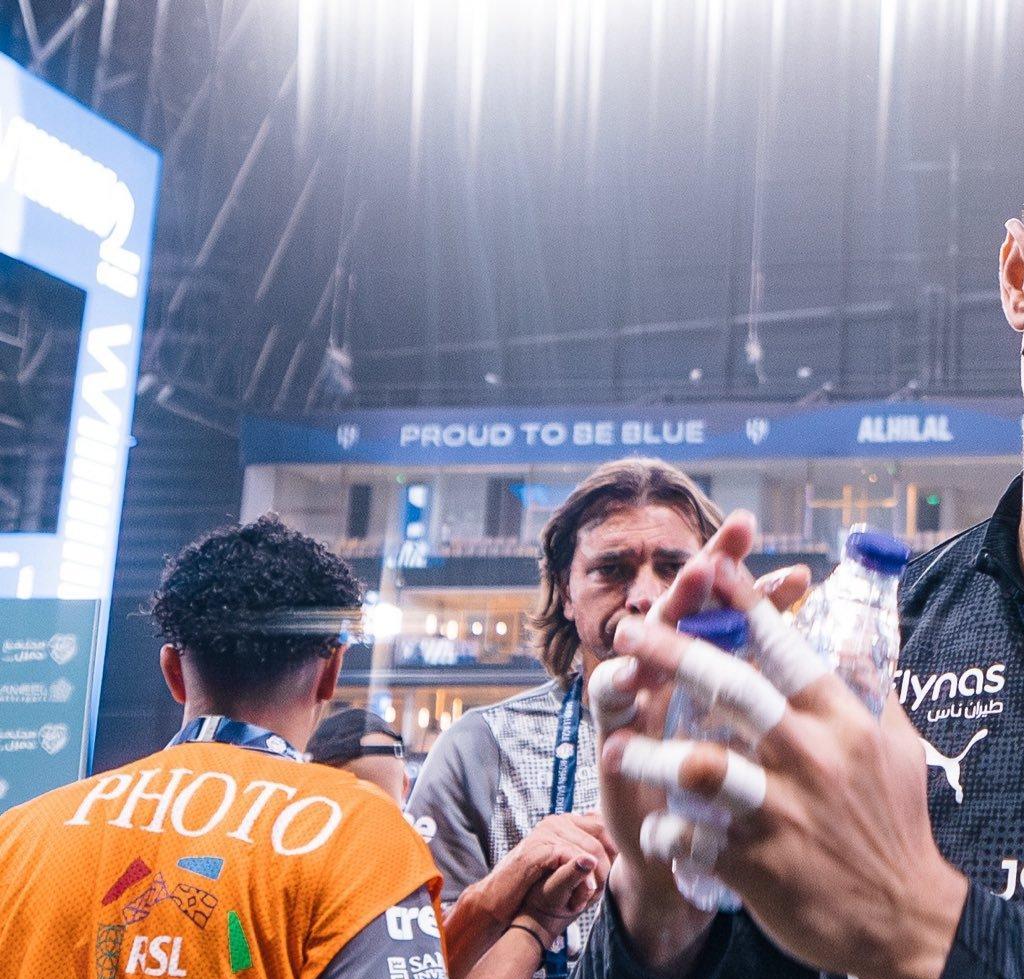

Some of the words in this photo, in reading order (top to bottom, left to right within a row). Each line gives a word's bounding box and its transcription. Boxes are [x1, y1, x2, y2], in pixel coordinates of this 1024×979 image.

[400, 413, 514, 448] PROUD
[520, 412, 567, 446] TO
[572, 411, 615, 445] BE
[620, 409, 704, 444] BLUE
[927, 702, 963, 723] ناس
[963, 699, 1004, 719] طيران
[65, 768, 343, 857] PHOTO
[125, 935, 188, 978] RSL
